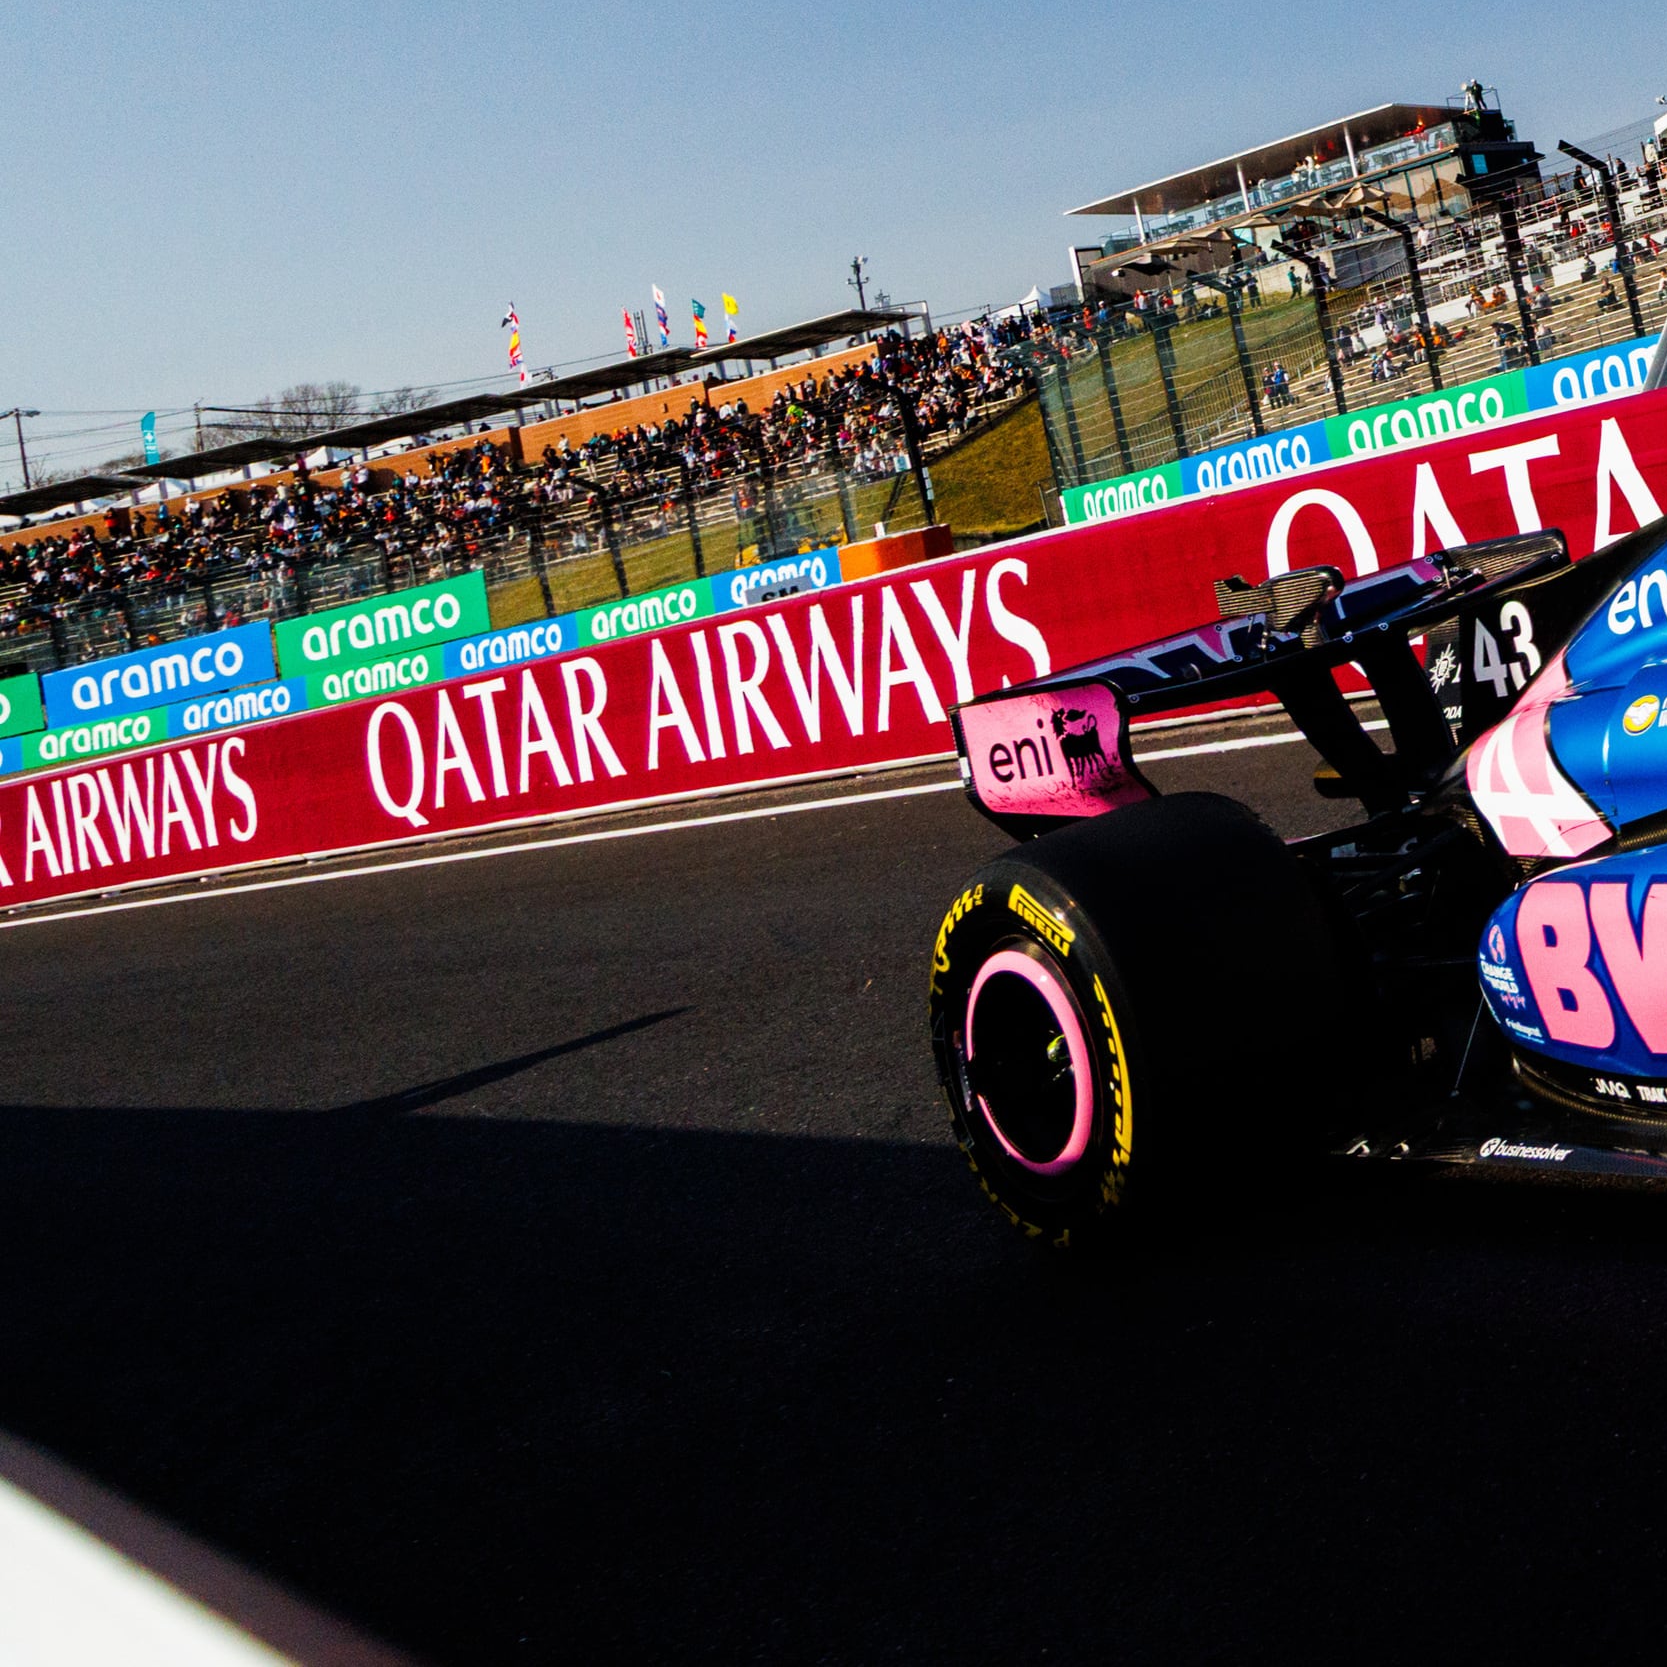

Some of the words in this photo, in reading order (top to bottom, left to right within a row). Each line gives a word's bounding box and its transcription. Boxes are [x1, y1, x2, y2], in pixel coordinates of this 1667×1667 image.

[1347, 387, 1504, 456] aramco
[1197, 435, 1311, 492] aramco
[1082, 473, 1168, 521] aramco
[300, 592, 462, 663] aramco
[590, 587, 698, 642] aramco
[459, 622, 564, 672] aramco
[1473, 600, 1542, 699] 43
[71, 641, 244, 711] aramco
[321, 652, 430, 702] aramco
[367, 655, 628, 829] QATAR
[646, 557, 1052, 772] AIRWAYS
[181, 684, 292, 732] aramco
[38, 714, 152, 762] aramco
[989, 718, 1055, 784] eni
[25, 736, 258, 883] AIRWAYS
[1007, 883, 1076, 957] PIRELLI
[1635, 1085, 1665, 1103] TRAK
[1496, 1139, 1575, 1162] businessolver
